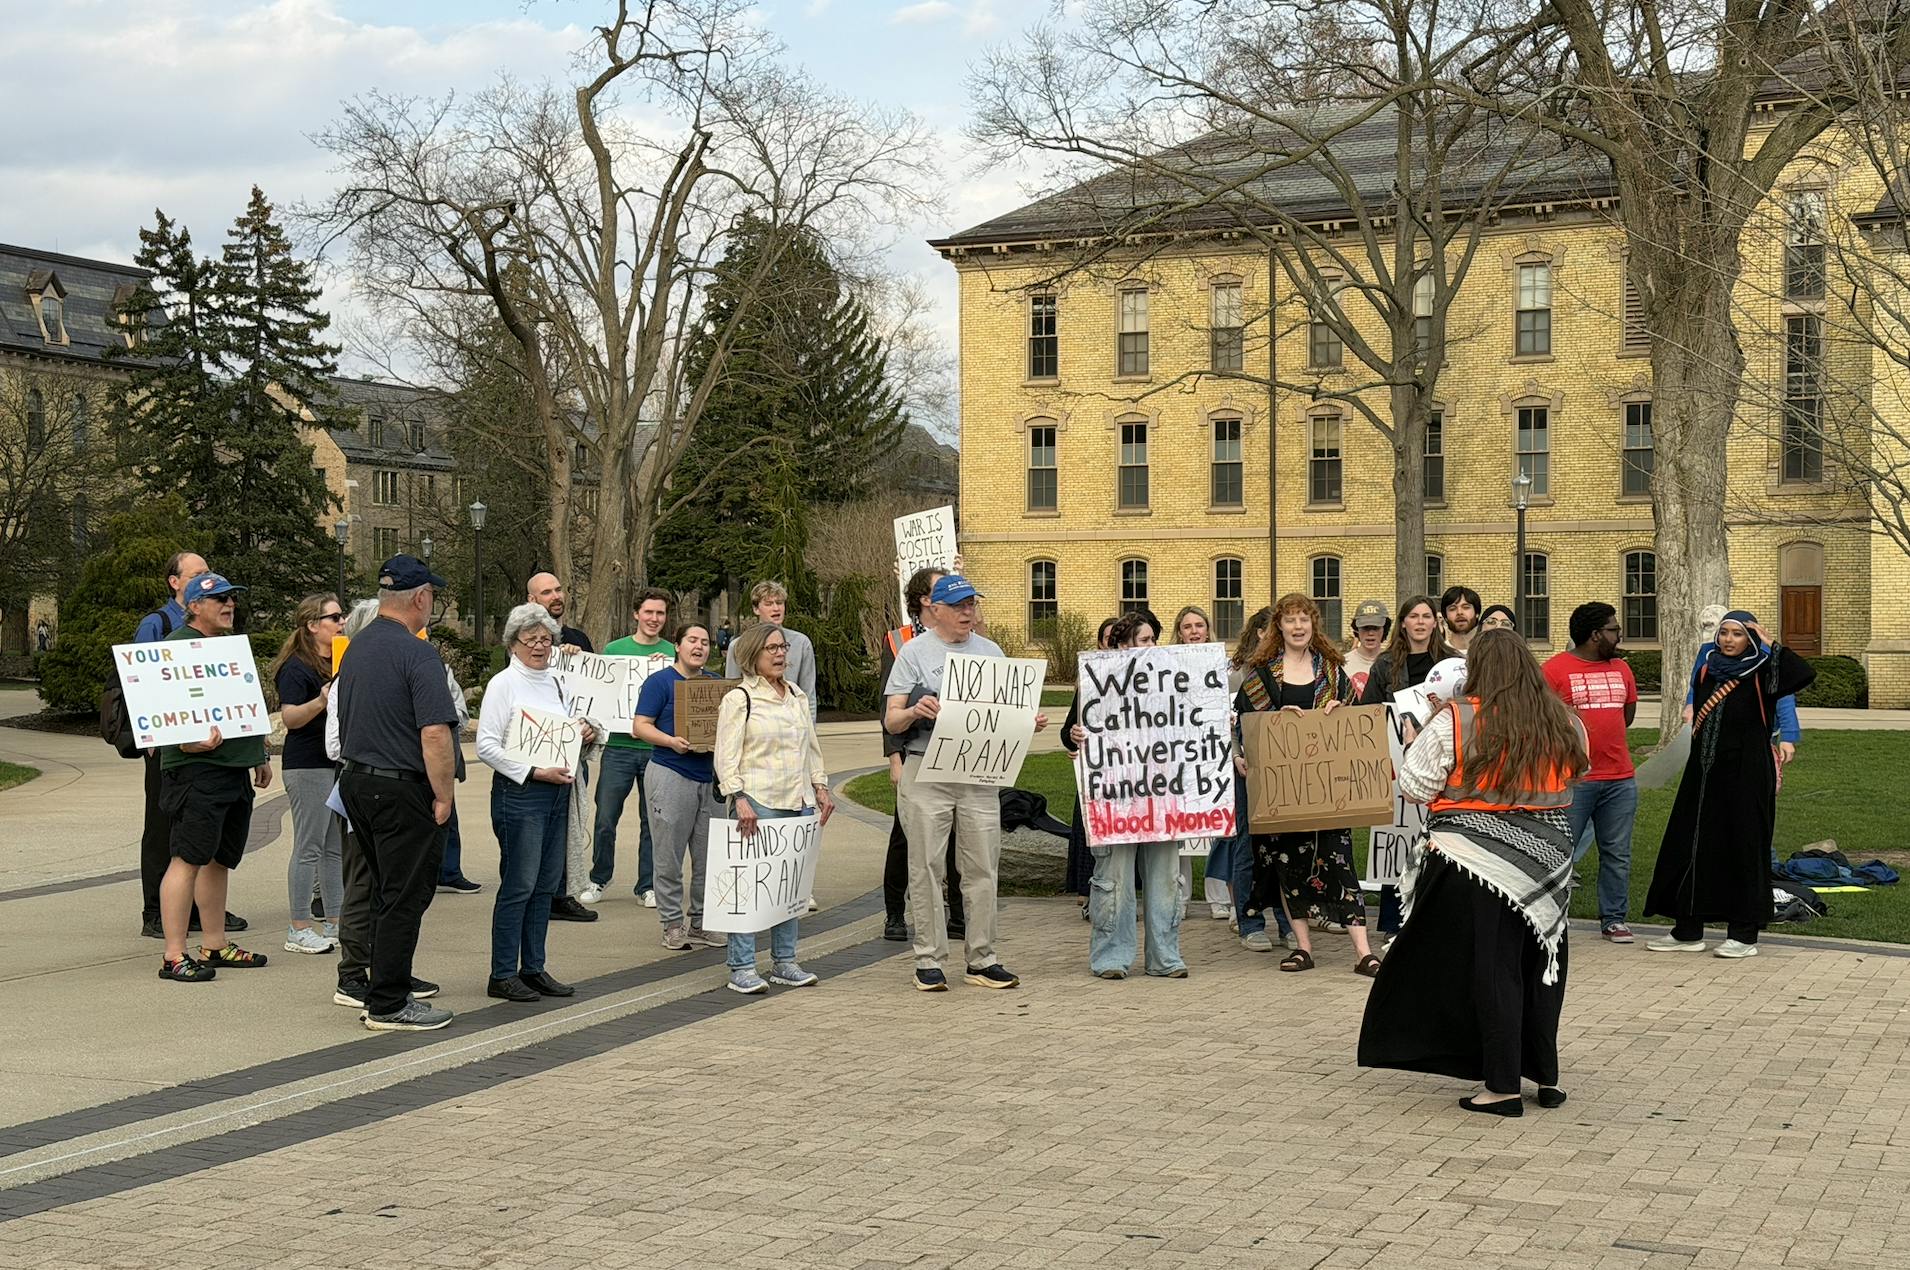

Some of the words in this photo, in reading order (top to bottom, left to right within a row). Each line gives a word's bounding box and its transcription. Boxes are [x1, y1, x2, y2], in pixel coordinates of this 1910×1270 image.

[901, 518, 925, 538] WAR
[926, 512, 943, 534] IS
[121, 648, 173, 666] YOUR
[161, 662, 240, 681] SILENCE
[580, 655, 616, 684] KIDS
[993, 662, 1037, 710] WAR
[1084, 657, 1190, 697] We're
[1204, 670, 1223, 689] a
[137, 703, 258, 730] COMPLICITY
[966, 708, 1000, 733] ON
[1082, 695, 1204, 733] Catholic
[520, 708, 576, 768] WAR
[927, 737, 1020, 773] IRAN
[1085, 725, 1232, 772] University
[1267, 721, 1300, 760] NO
[1319, 714, 1376, 752] WAR
[1195, 764, 1231, 804] by
[1264, 760, 1335, 808] DIVEST
[1349, 758, 1393, 801] ARMS
[727, 824, 788, 860] HANDS
[793, 821, 818, 853] OFF
[1374, 831, 1419, 879] FRO
[728, 855, 805, 915] IRAN
